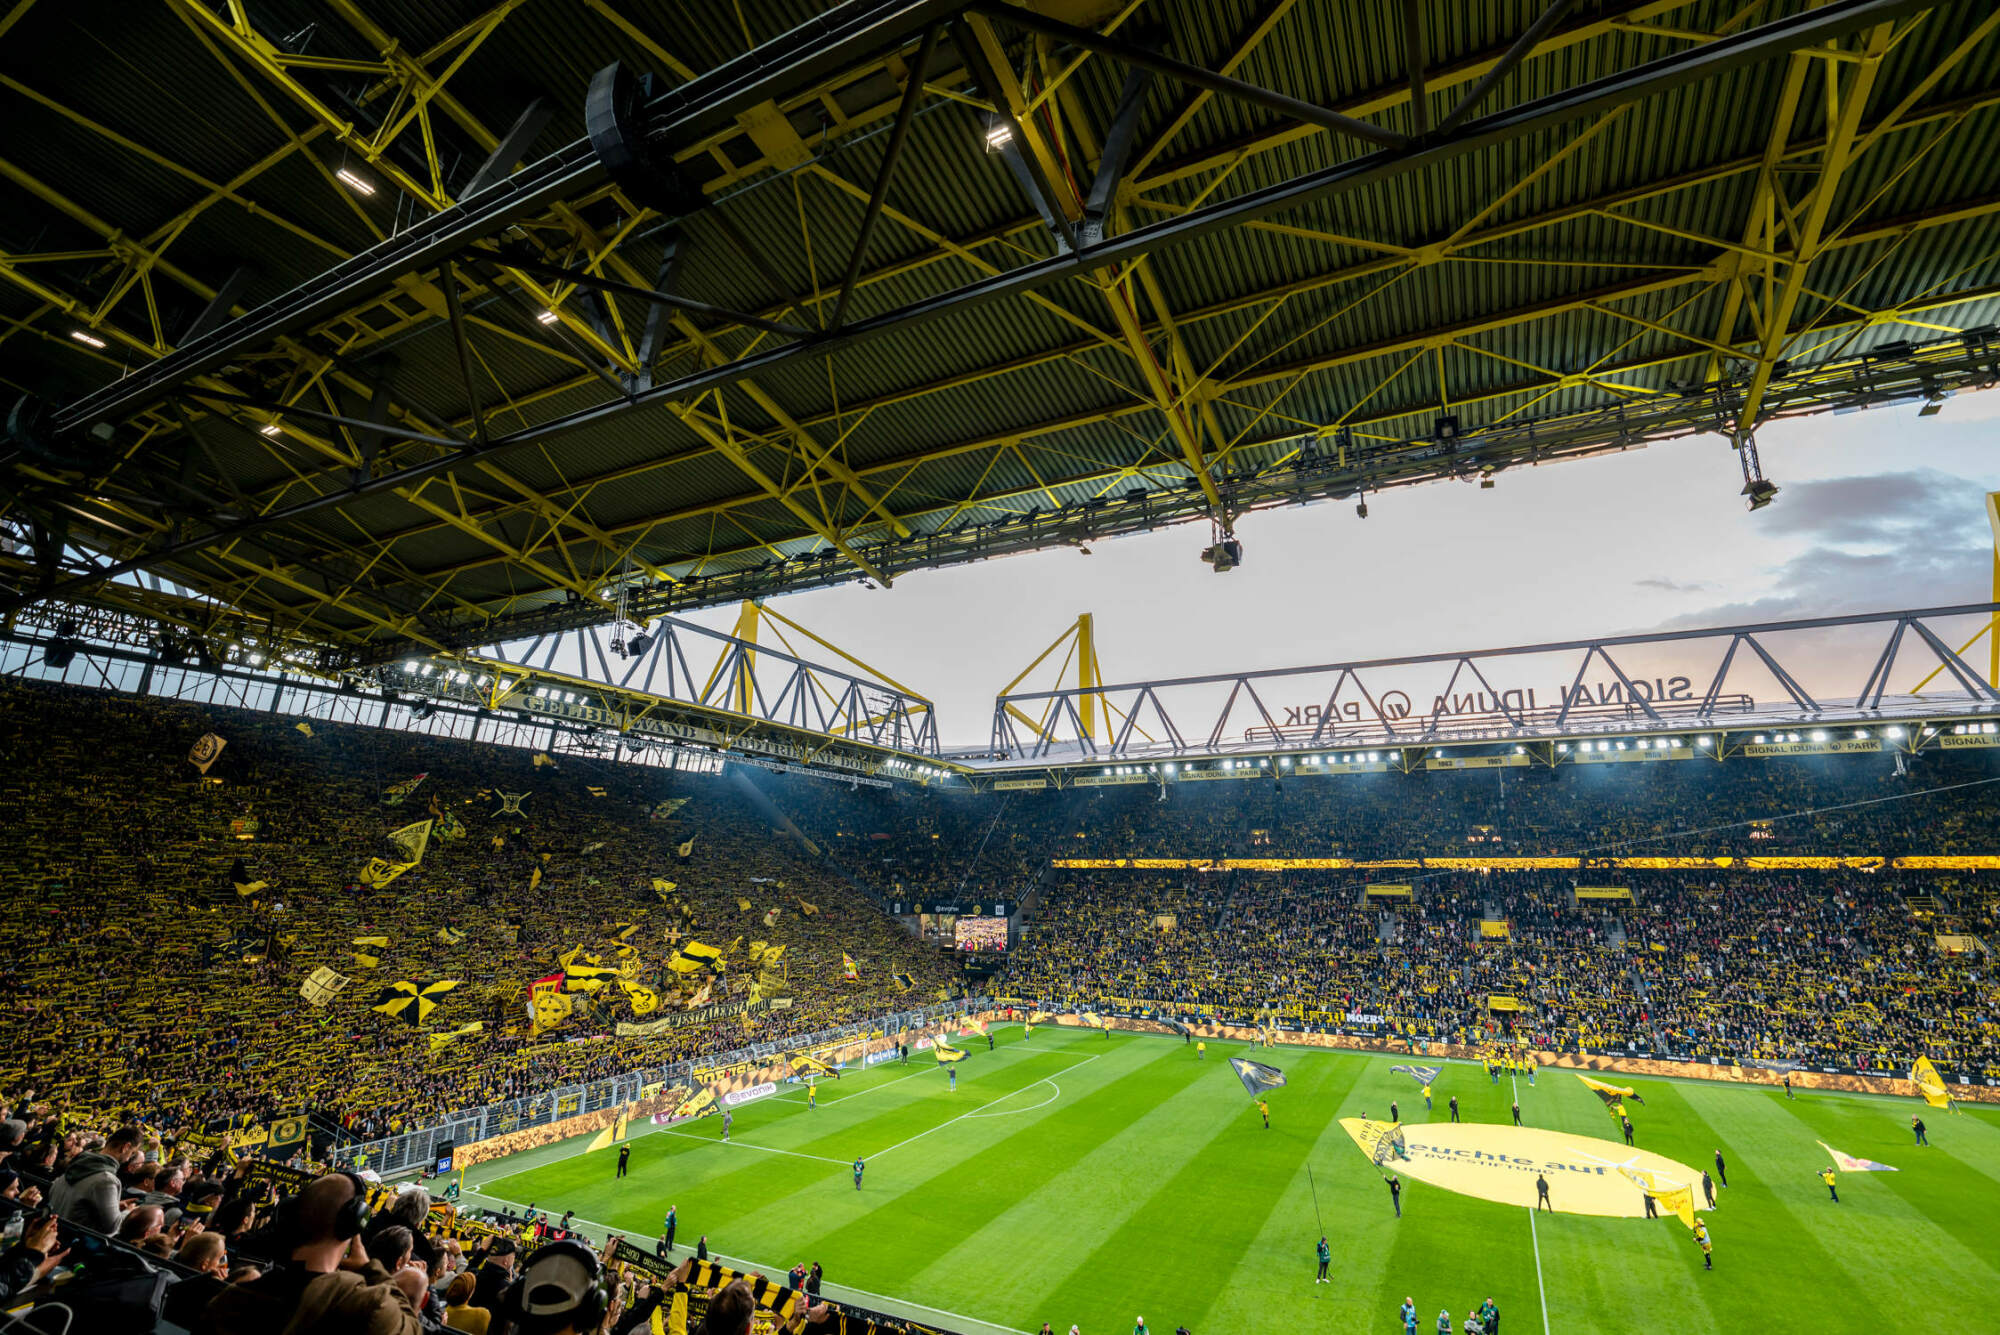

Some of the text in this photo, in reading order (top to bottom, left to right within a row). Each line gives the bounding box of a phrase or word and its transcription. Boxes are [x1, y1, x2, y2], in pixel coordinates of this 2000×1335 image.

[634, 717, 697, 738] WAND
[1747, 741, 1879, 755] SIGNAL IDUNA PARK
[1943, 736, 1989, 746] SIGNAL
[1239, 769, 1259, 777] PARK
[1345, 1013, 1385, 1025] MOERS
[741, 1083, 774, 1099] EVONIK
[1408, 1143, 1609, 1176] euchte auf
